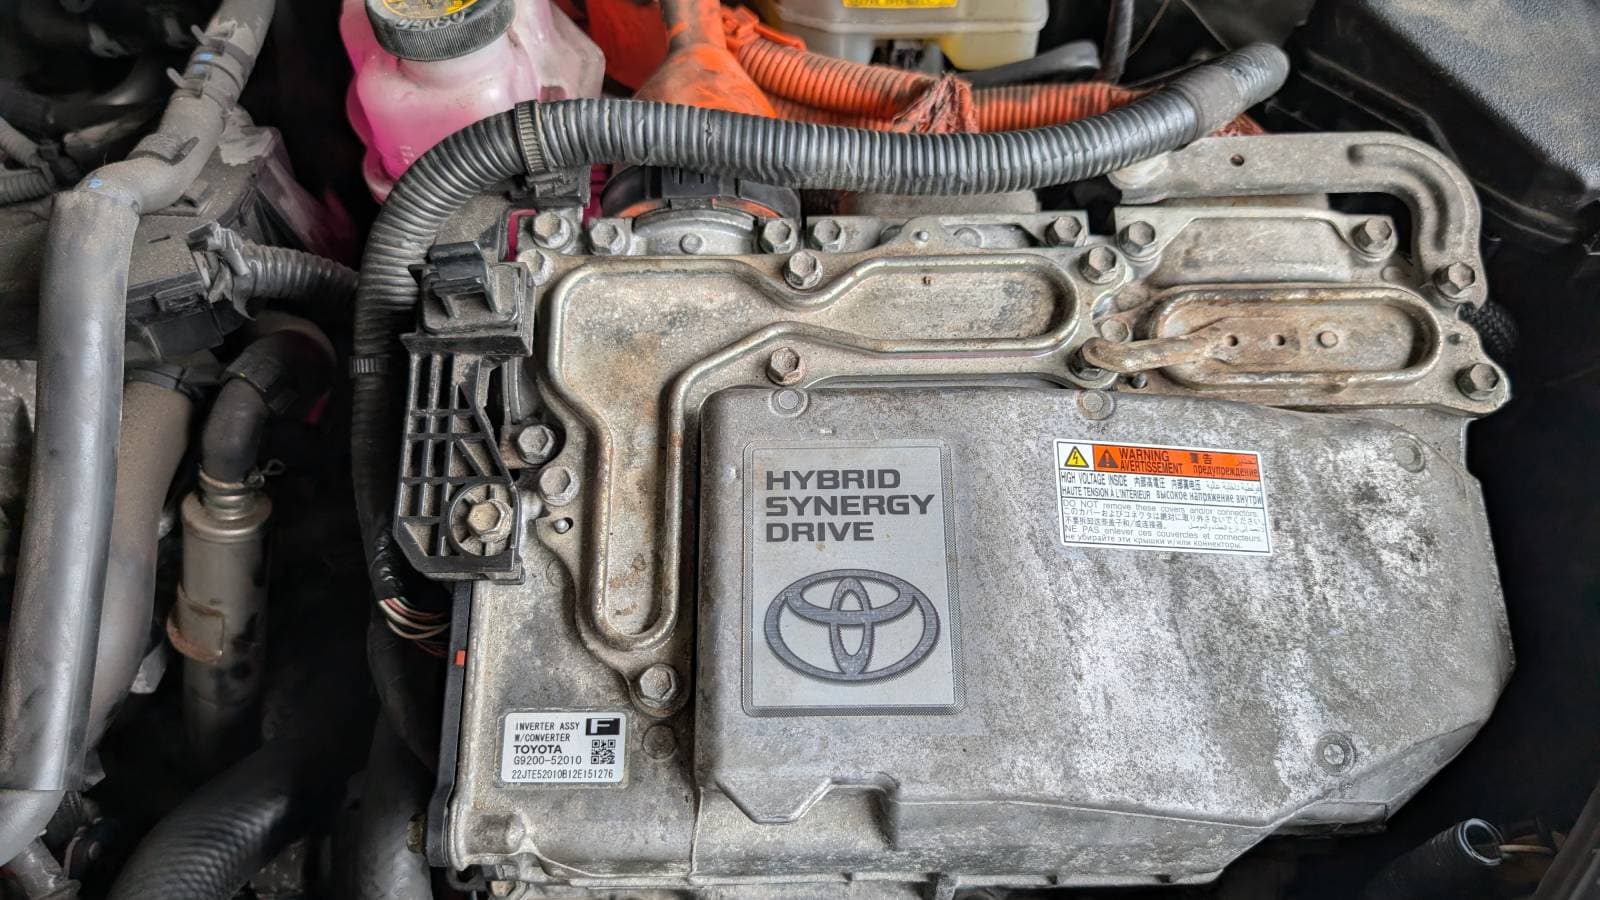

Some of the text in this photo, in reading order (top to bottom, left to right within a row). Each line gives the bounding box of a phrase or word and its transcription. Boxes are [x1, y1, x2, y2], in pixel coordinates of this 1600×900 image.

[394, 11, 465, 30] DENSO
[1119, 448, 1169, 461] WARNING
[1120, 461, 1183, 474] AVERTISSEMENT
[1193, 465, 1258, 477] предупреждение
[766, 469, 901, 490] HYBRID
[1061, 472, 1128, 487] HIGH VOLTAGE INSIDE
[1062, 487, 1082, 497] HAUTE
[1083, 488, 1108, 498] TENSION
[1189, 492, 1234, 505] напряжение
[1236, 494, 1263, 506] внутри
[766, 494, 936, 516] SYNERGY
[1063, 500, 1076, 508] DO
[1080, 501, 1098, 509] NOT
[1102, 502, 1132, 510] remove
[1135, 503, 1157, 511] these
[1160, 505, 1185, 514] covers
[766, 522, 874, 542] DRIVE
[1064, 525, 1077, 533] NE
[1082, 526, 1099, 534] PAS
[1156, 530, 1198, 539] couvercles
[1077, 534, 1115, 543] убирайте
[1134, 538, 1165, 546] крышки
[1167, 539, 1191, 547] и/или
[515, 721, 580, 730] INVERTER ASSY
[590, 719, 615, 734] F
[514, 733, 571, 742] W/CONVERTER
[513, 745, 562, 754] TOYOTA
[513, 756, 582, 765] G9200-52010
[511, 769, 614, 779] 22JTE52010B12E151276
